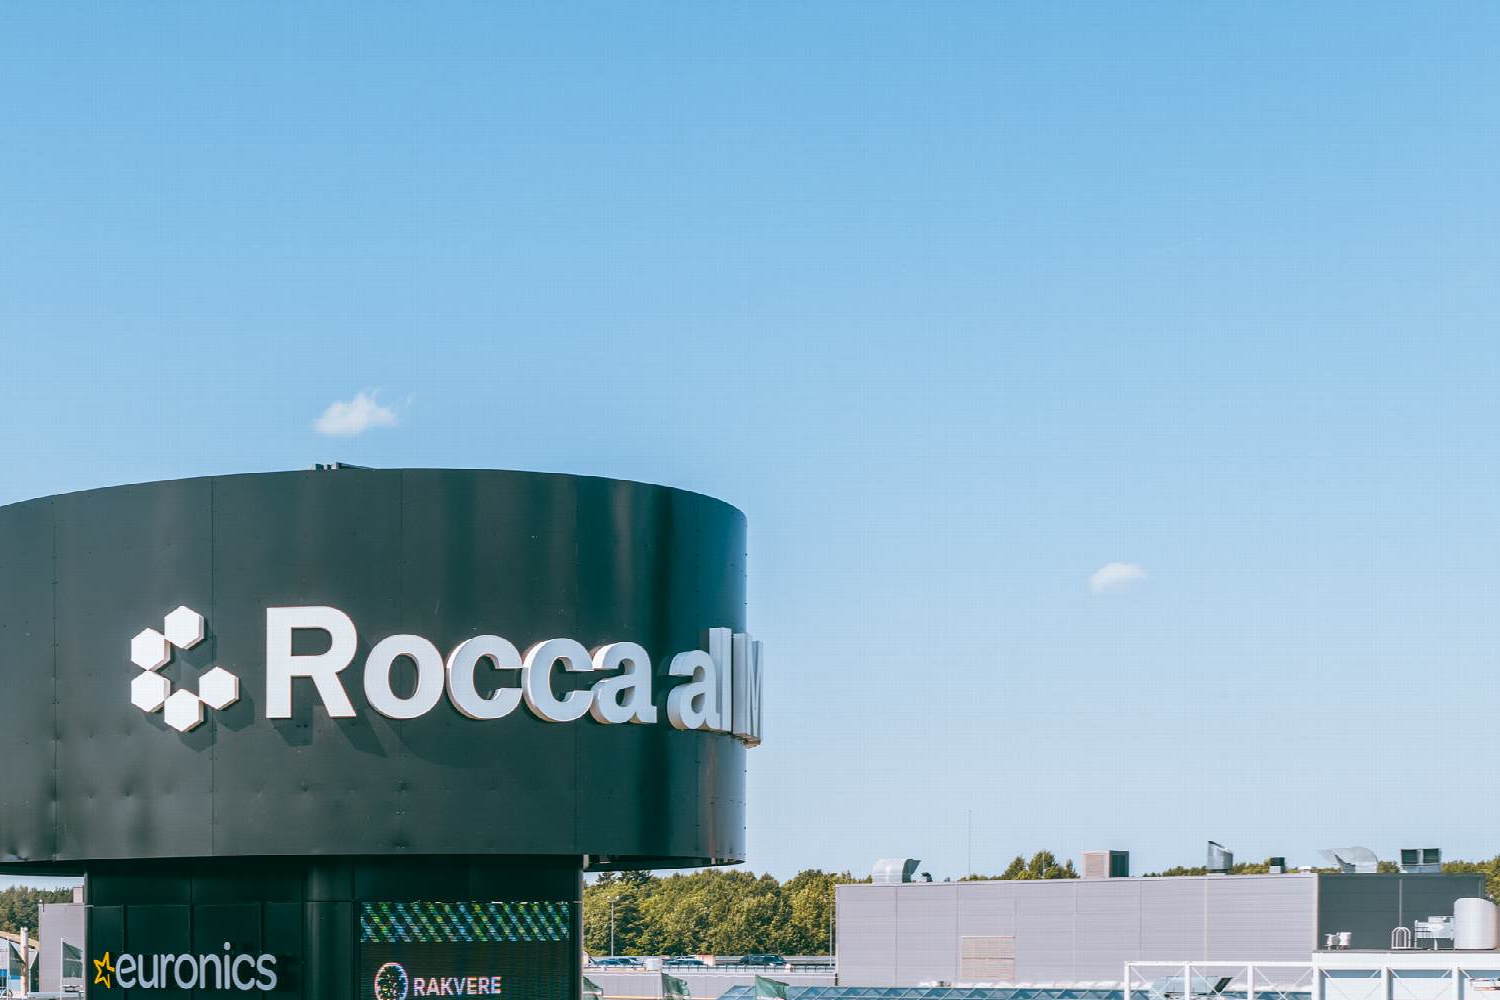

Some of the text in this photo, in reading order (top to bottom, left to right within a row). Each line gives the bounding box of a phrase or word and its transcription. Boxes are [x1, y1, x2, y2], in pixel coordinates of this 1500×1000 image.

[266, 606, 657, 726] Rocca
[667, 627, 732, 732] al
[116, 942, 277, 991] euronics
[413, 975, 502, 997] RAKVERE
